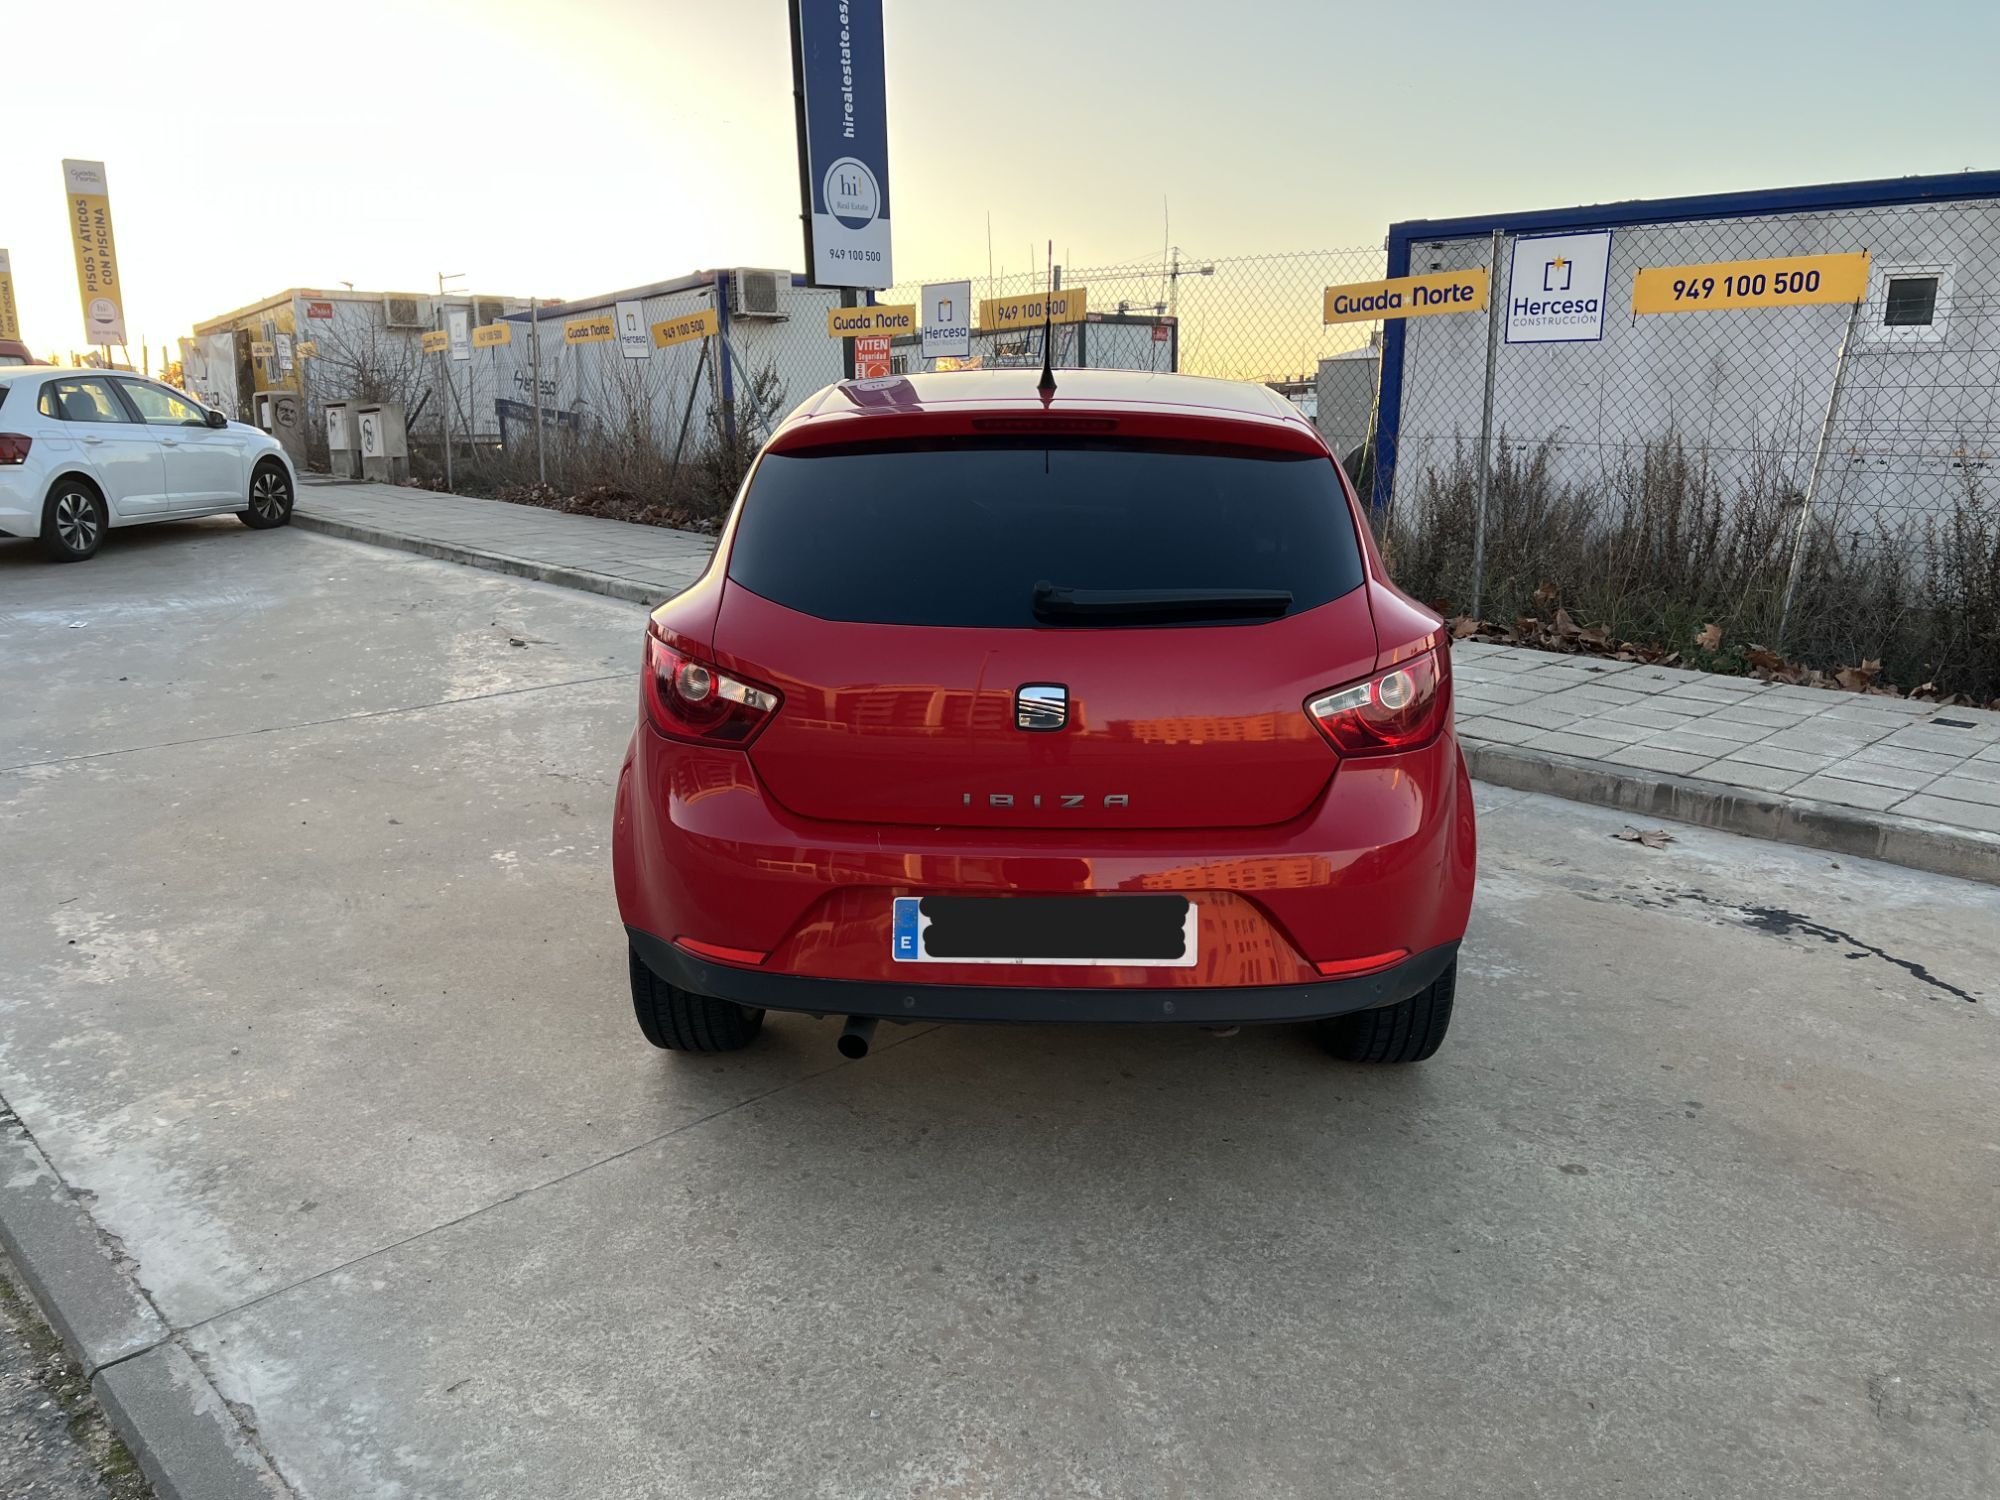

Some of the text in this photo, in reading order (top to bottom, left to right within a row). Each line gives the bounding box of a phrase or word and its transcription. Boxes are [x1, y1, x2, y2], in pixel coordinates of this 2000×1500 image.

[840, 174, 863, 196] hi!
[837, 201, 868, 211] Real Estate
[76, 199, 98, 292] PISOS Y ÁTICOS
[94, 208, 113, 285] CON PISCINA
[829, 248, 881, 262] 949 100 500
[1673, 270, 1820, 300] 949 100 500
[1334, 283, 1474, 314] Guada Norte
[998, 304, 1018, 321] 949
[1022, 302, 1042, 318] 100
[1513, 297, 1597, 316] Hercesa
[833, 313, 909, 330] Guada Norte
[1513, 314, 1597, 327] CONSTRUCCIÓN
[568, 324, 610, 338] Guada Norte
[663, 319, 705, 339] 949 100 500
[924, 326, 967, 339] Hercesa
[622, 333, 646, 343] Hercesa
[857, 339, 888, 350] VITEN
[858, 351, 887, 362] Seguridad
[963, 793, 1128, 808] IBIZA
[901, 936, 911, 949] E
